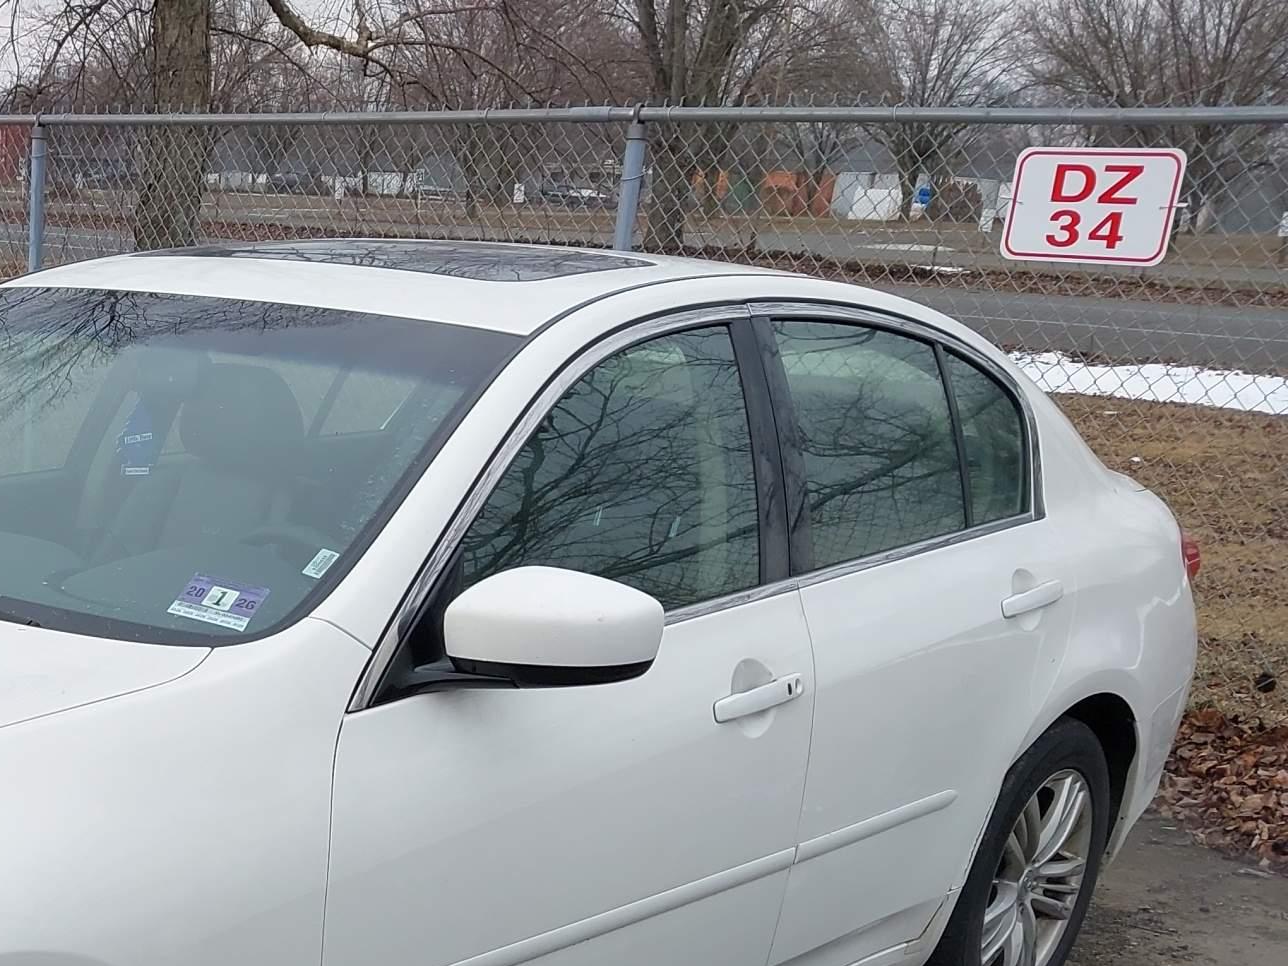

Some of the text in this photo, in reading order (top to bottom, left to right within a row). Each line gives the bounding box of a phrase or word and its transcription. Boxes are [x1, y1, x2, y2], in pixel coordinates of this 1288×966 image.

[1050, 164, 1145, 205] DZ
[1045, 209, 1124, 249] 34
[186, 585, 257, 610] 20 1 26
